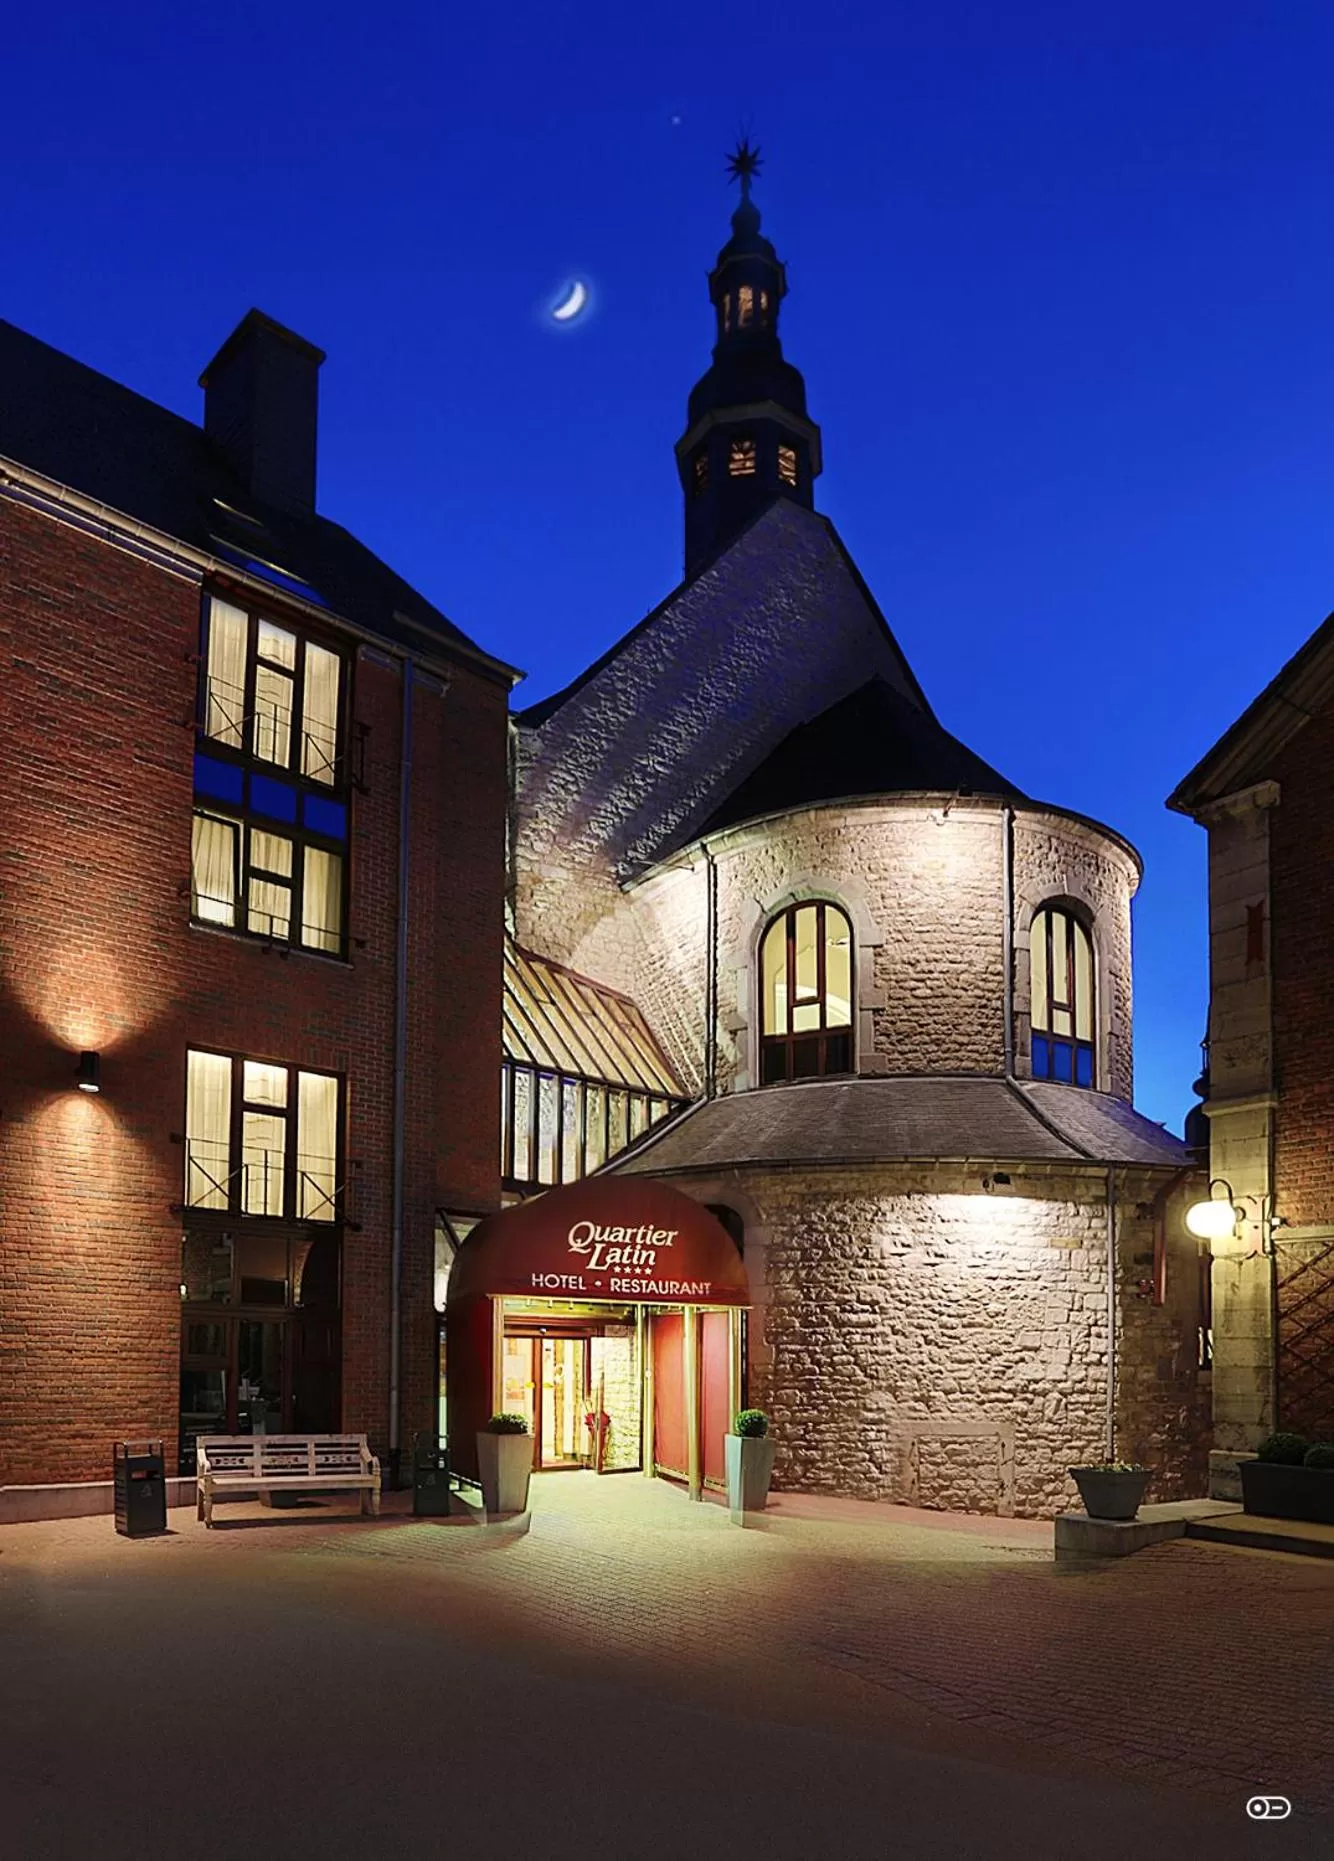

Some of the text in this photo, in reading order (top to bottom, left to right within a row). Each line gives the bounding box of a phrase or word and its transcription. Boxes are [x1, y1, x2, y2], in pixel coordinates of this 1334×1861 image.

[568, 1221, 679, 1253] Quartier
[586, 1243, 656, 1270] Latin
[531, 1272, 712, 1296] HOTEL RESTAURANT
